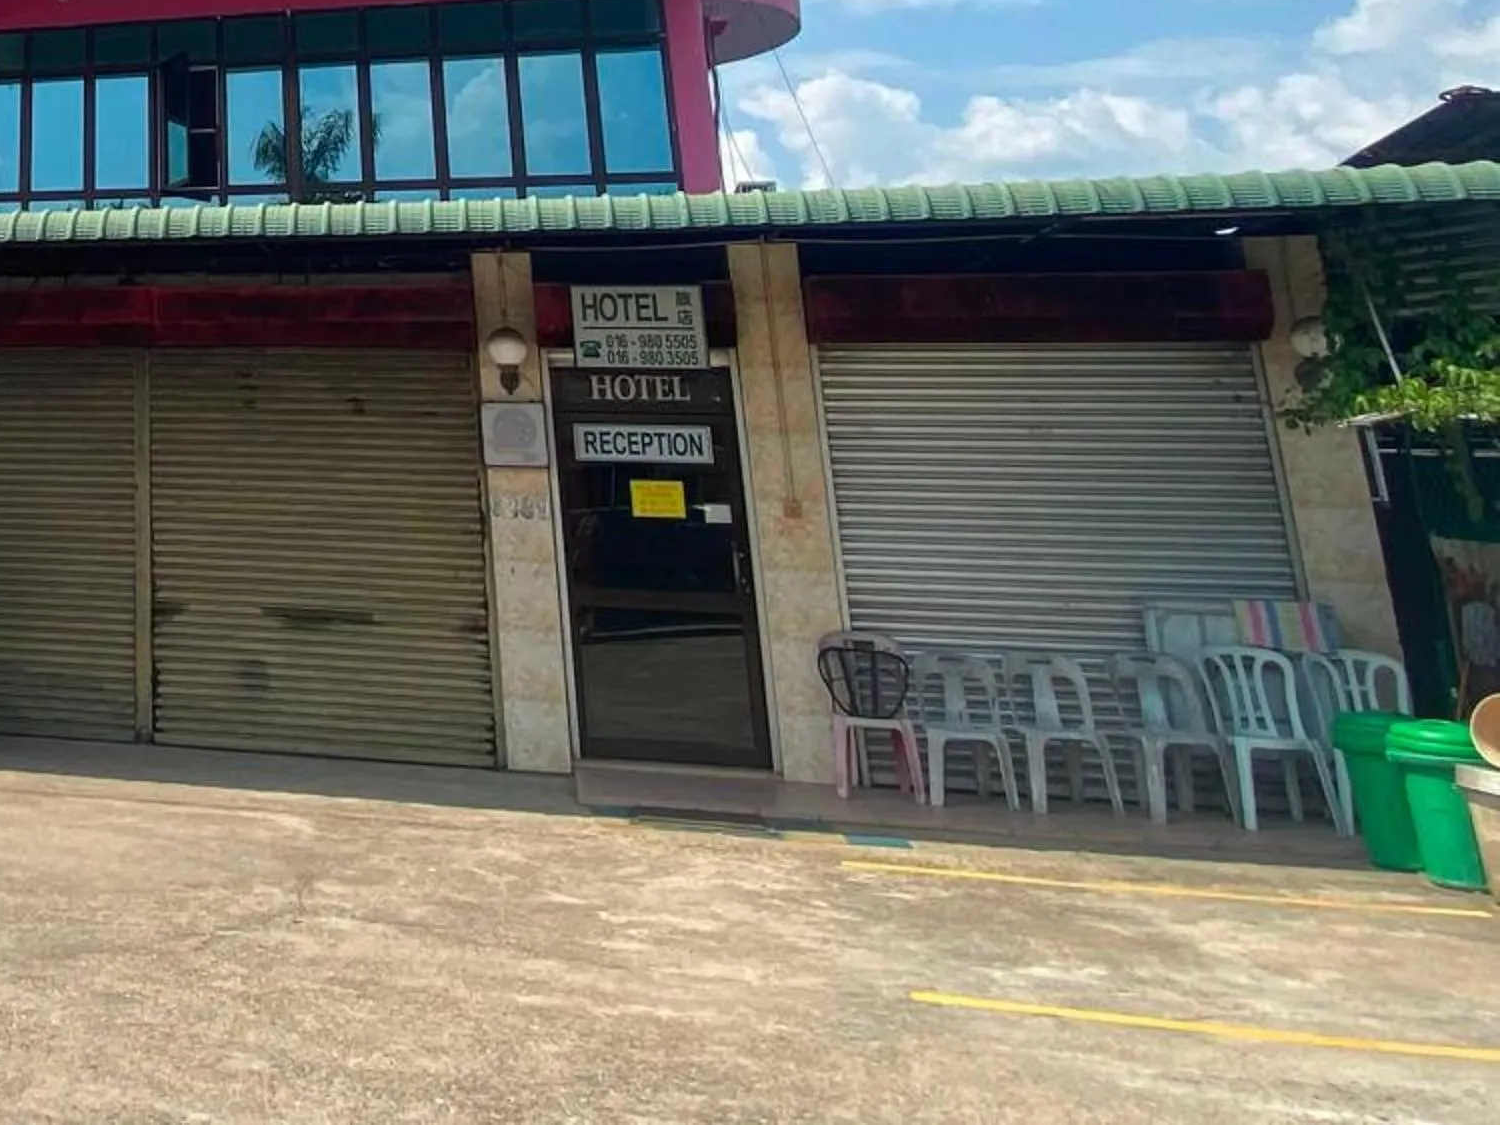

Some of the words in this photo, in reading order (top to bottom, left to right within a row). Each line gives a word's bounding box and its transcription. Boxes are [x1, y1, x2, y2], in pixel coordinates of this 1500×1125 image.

[581, 292, 669, 322] HOTEL
[590, 375, 691, 401] HOTEL
[583, 431, 704, 457] RECEPTION
